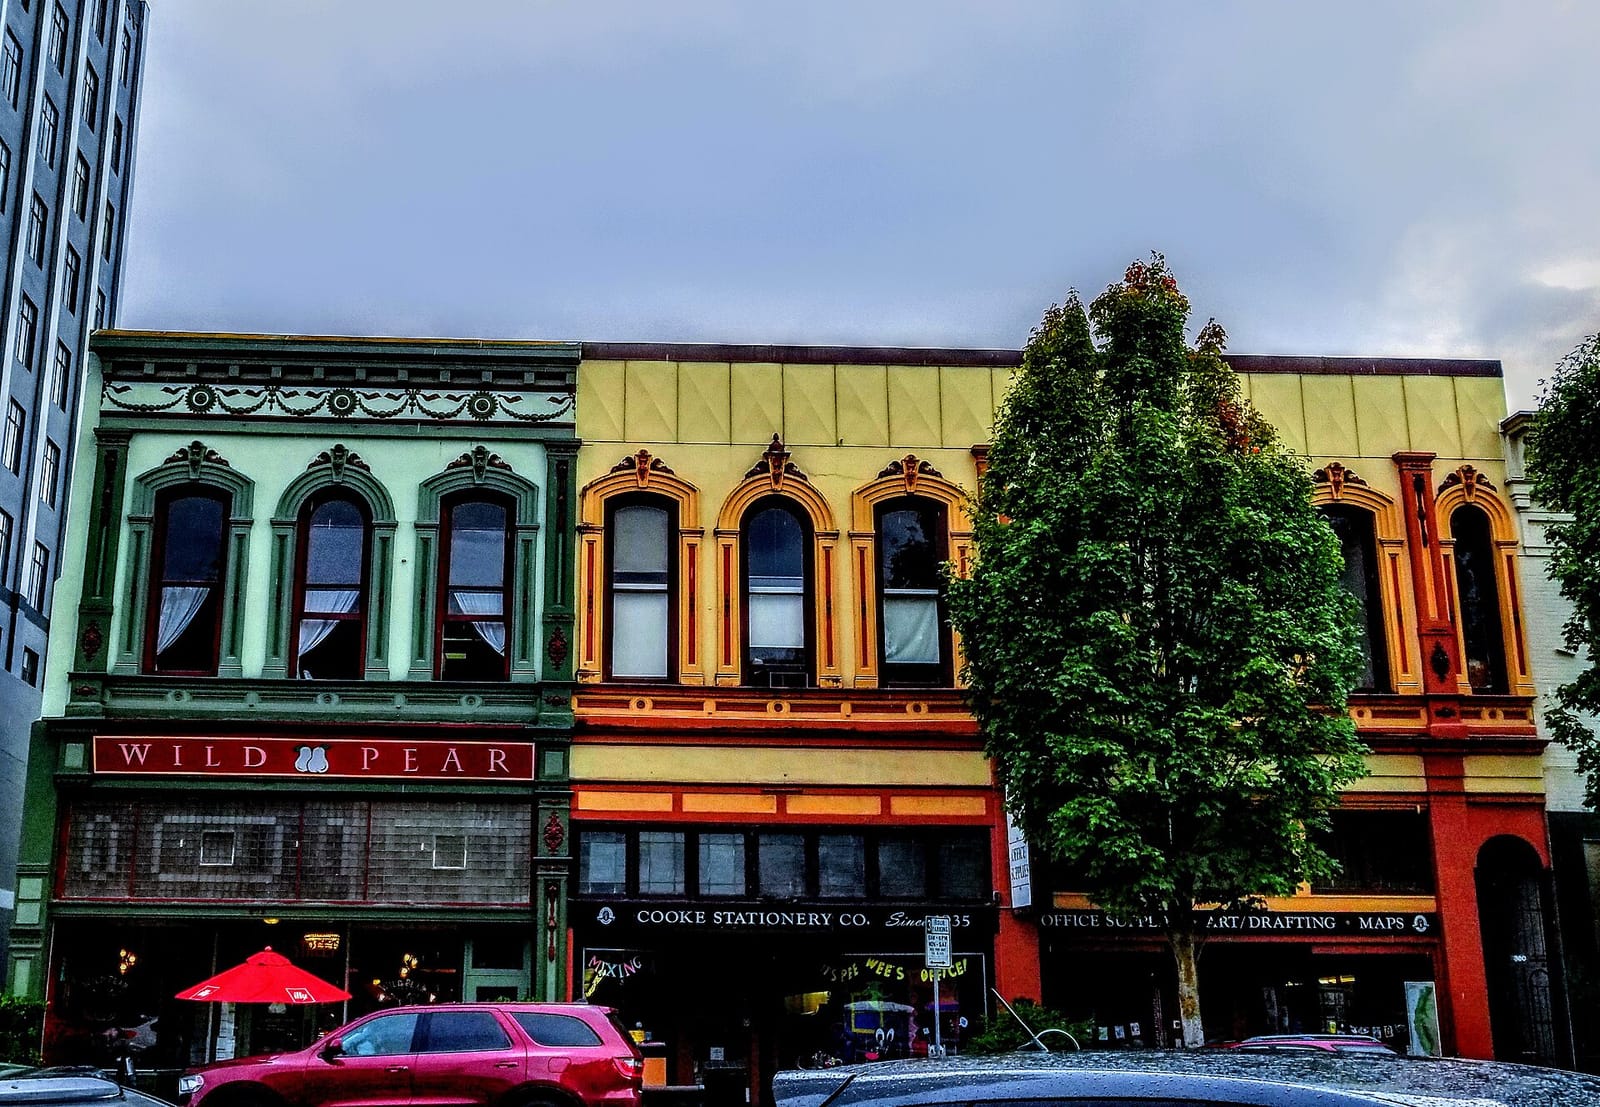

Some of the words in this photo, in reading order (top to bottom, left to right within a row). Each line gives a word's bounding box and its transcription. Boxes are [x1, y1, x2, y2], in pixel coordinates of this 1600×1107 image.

[118, 743, 267, 767] WILD
[361, 747, 510, 773] PEAR
[637, 910, 706, 924] COOKE
[713, 911, 832, 926] STATIONERY
[839, 913, 870, 926] CO.
[1041, 914, 1100, 927] OFFICE
[1359, 916, 1405, 930] MAPS
[588, 955, 642, 978] MIXING
[840, 963, 859, 983] PEE
[865, 958, 905, 981] WEE'S
